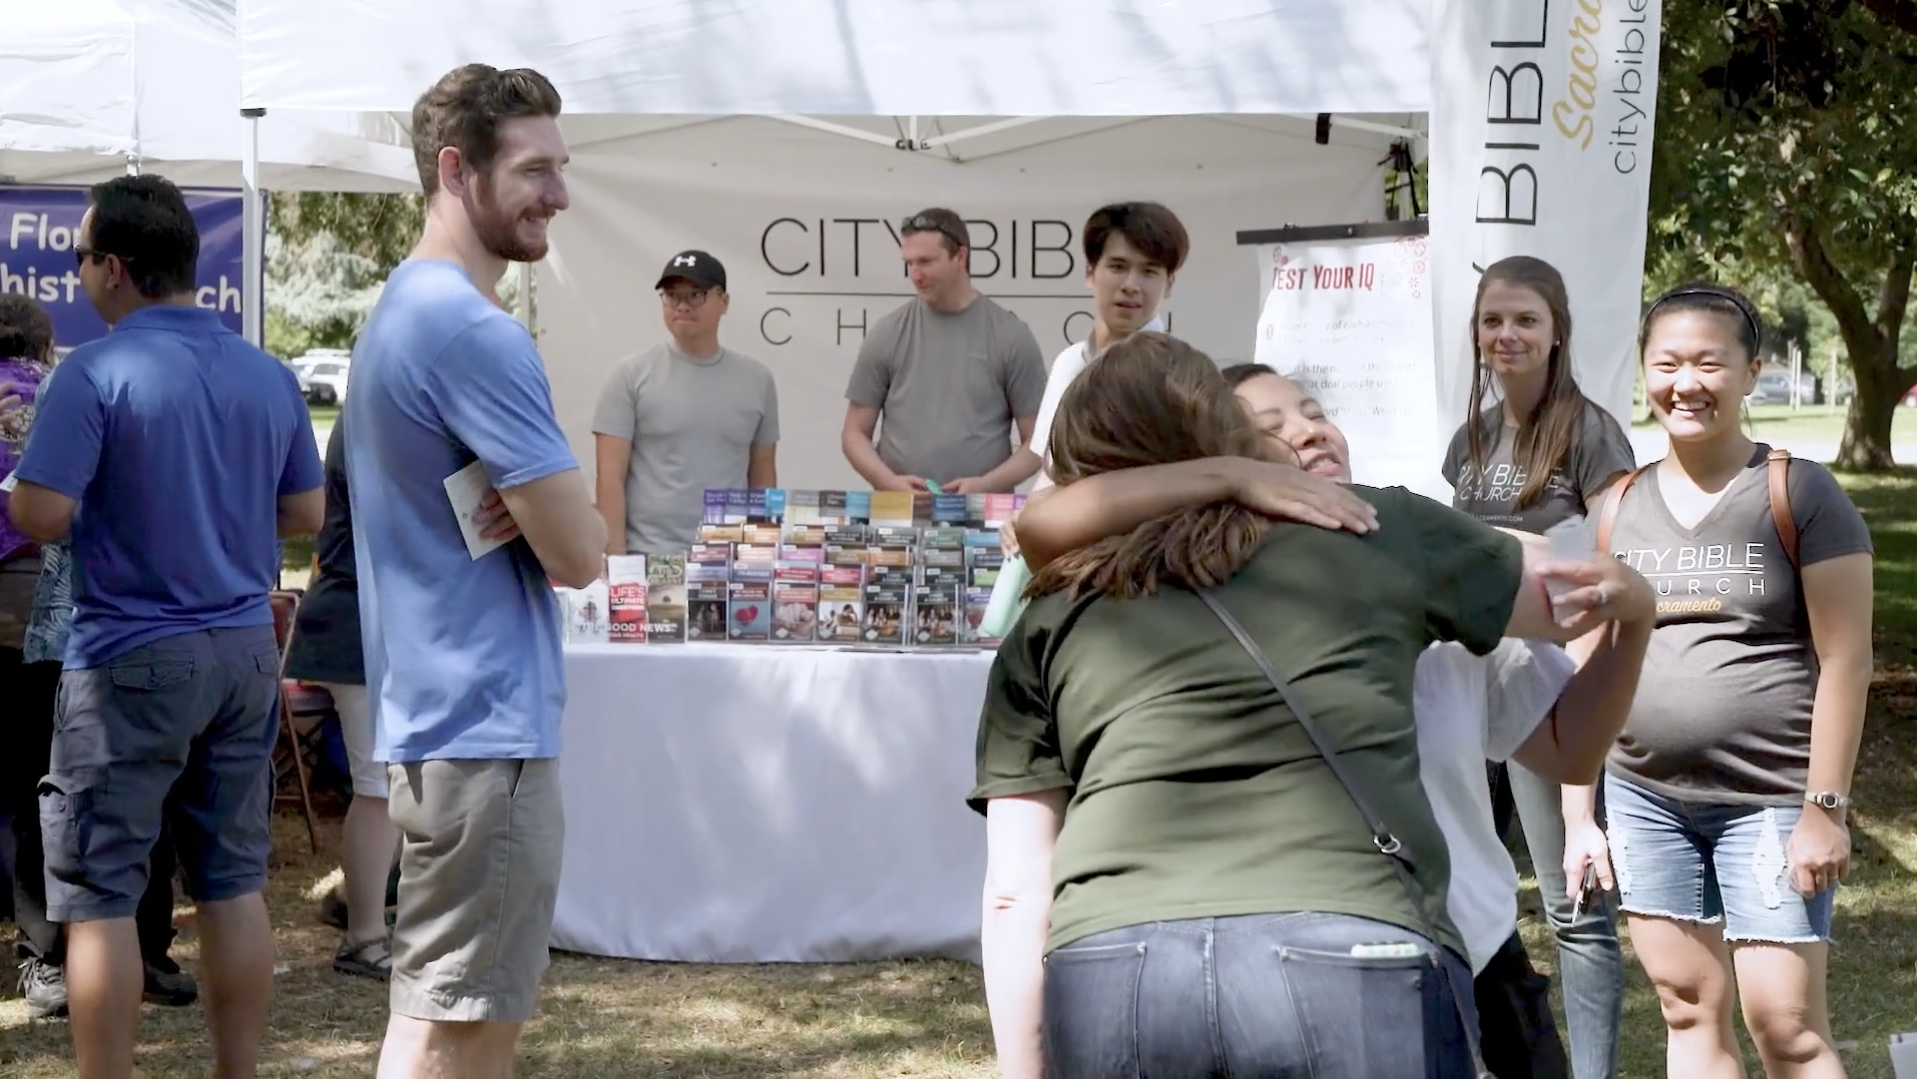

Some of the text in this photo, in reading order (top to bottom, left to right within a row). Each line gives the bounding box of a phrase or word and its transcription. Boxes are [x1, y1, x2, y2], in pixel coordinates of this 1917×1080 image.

[961, 218, 1075, 279] BIB
[1313, 264, 1354, 290] YOUR
[1358, 262, 1375, 292] IQ
[1677, 542, 1765, 571] BIBLE
[610, 586, 645, 598] LIFE'S
[1656, 577, 1766, 597] URCH
[640, 622, 671, 633] NEWS
